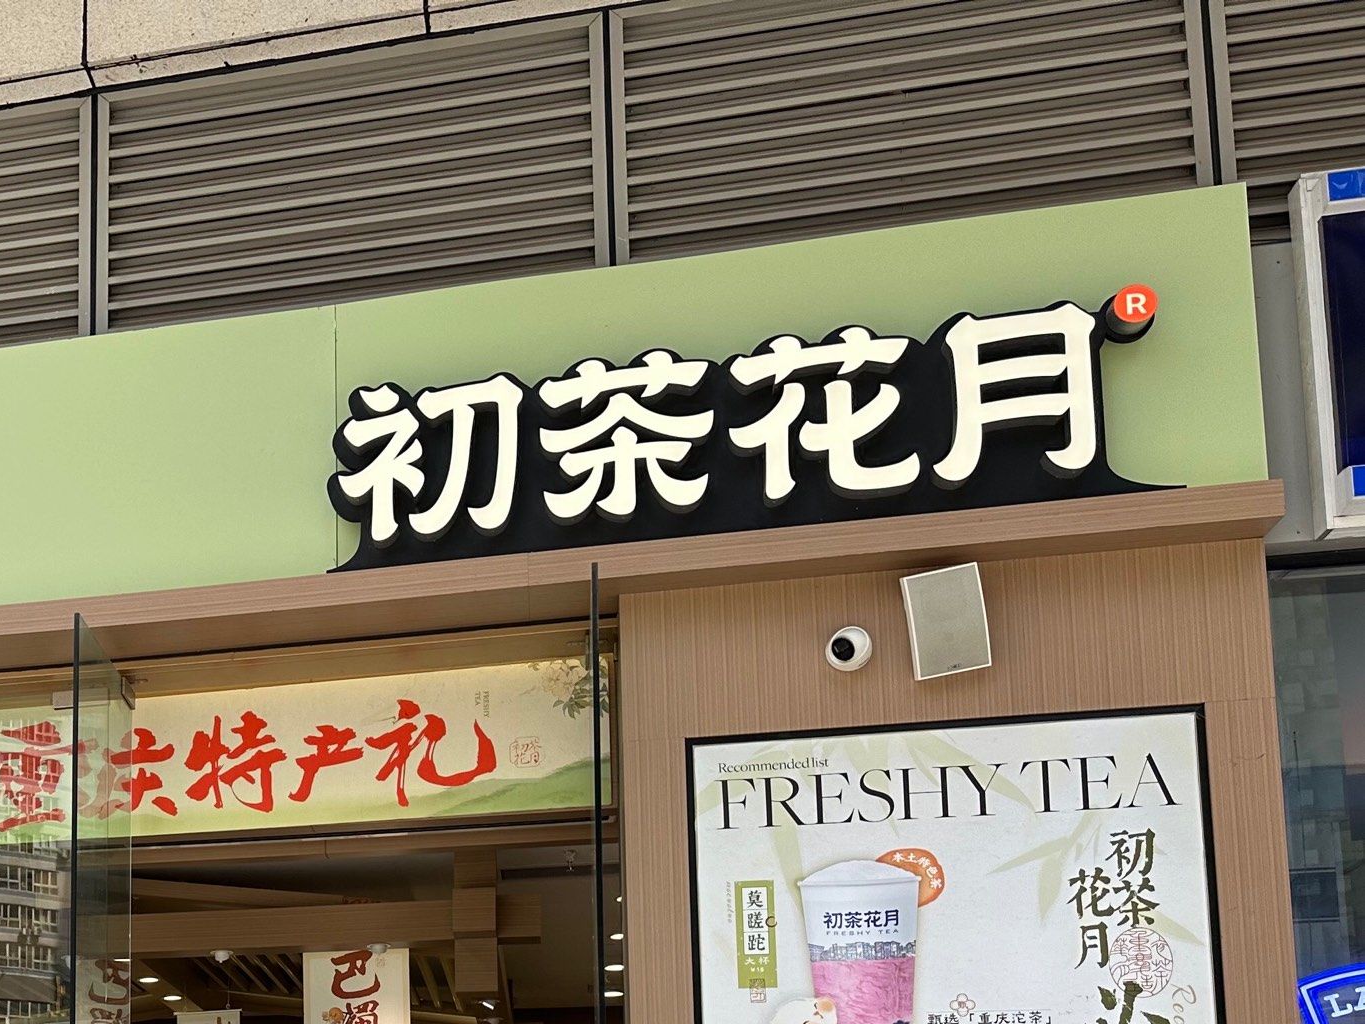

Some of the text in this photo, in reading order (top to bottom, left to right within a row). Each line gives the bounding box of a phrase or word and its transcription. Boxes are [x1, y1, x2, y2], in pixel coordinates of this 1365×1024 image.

[337, 302, 1100, 544] 初茶花月
[714, 752, 1183, 831] FRESHY TEA
[718, 757, 829, 774] Recommended list
[746, 889, 767, 952] 莫蹉跎
[823, 909, 900, 929] 初茶花月
